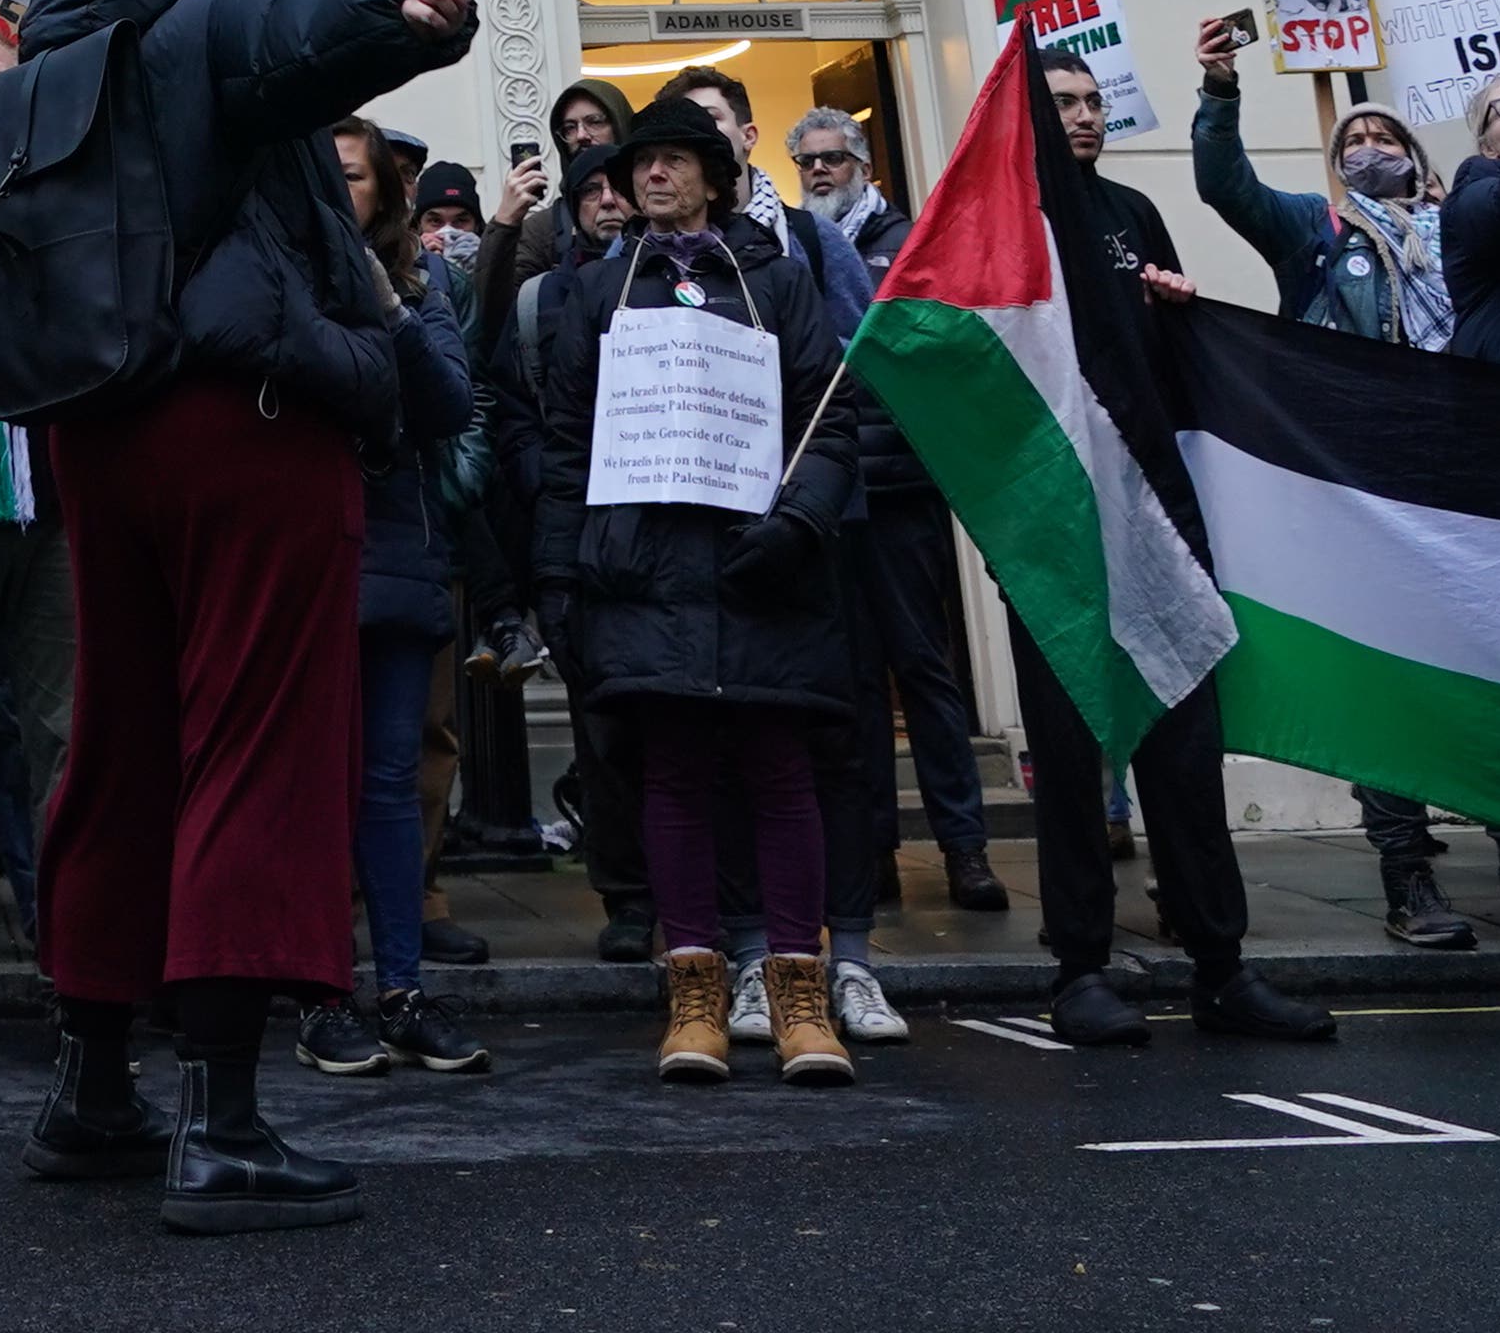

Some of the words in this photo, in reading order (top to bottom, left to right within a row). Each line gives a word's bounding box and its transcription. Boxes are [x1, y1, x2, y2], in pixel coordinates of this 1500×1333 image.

[665, 15, 720, 29] ADAM
[728, 14, 794, 28] HOUSE
[1282, 15, 1369, 54] STOP
[612, 348, 627, 359] The
[627, 343, 668, 358] European
[671, 339, 701, 351] Nazis
[704, 345, 766, 367] exterminated
[658, 359, 671, 370] my
[675, 356, 711, 372] family
[630, 385, 659, 398] Israeli
[661, 383, 726, 400] Ambassador
[728, 392, 766, 410] defends
[669, 399, 728, 418] Palestinian
[731, 407, 769, 427] families
[619, 431, 640, 443] Stop
[642, 429, 656, 440] the
[659, 427, 710, 441] Genocide
[713, 433, 723, 443] of
[725, 435, 751, 450] Gaza
[603, 458, 617, 469] We
[619, 455, 652, 468] Israelis
[654, 454, 671, 466] live
[675, 457, 690, 466] on
[694, 455, 712, 468] the
[714, 459, 736, 474] land
[738, 465, 770, 480] stolen
[627, 474, 650, 485] from
[653, 473, 669, 483] the
[672, 472, 739, 492] Palestinians
